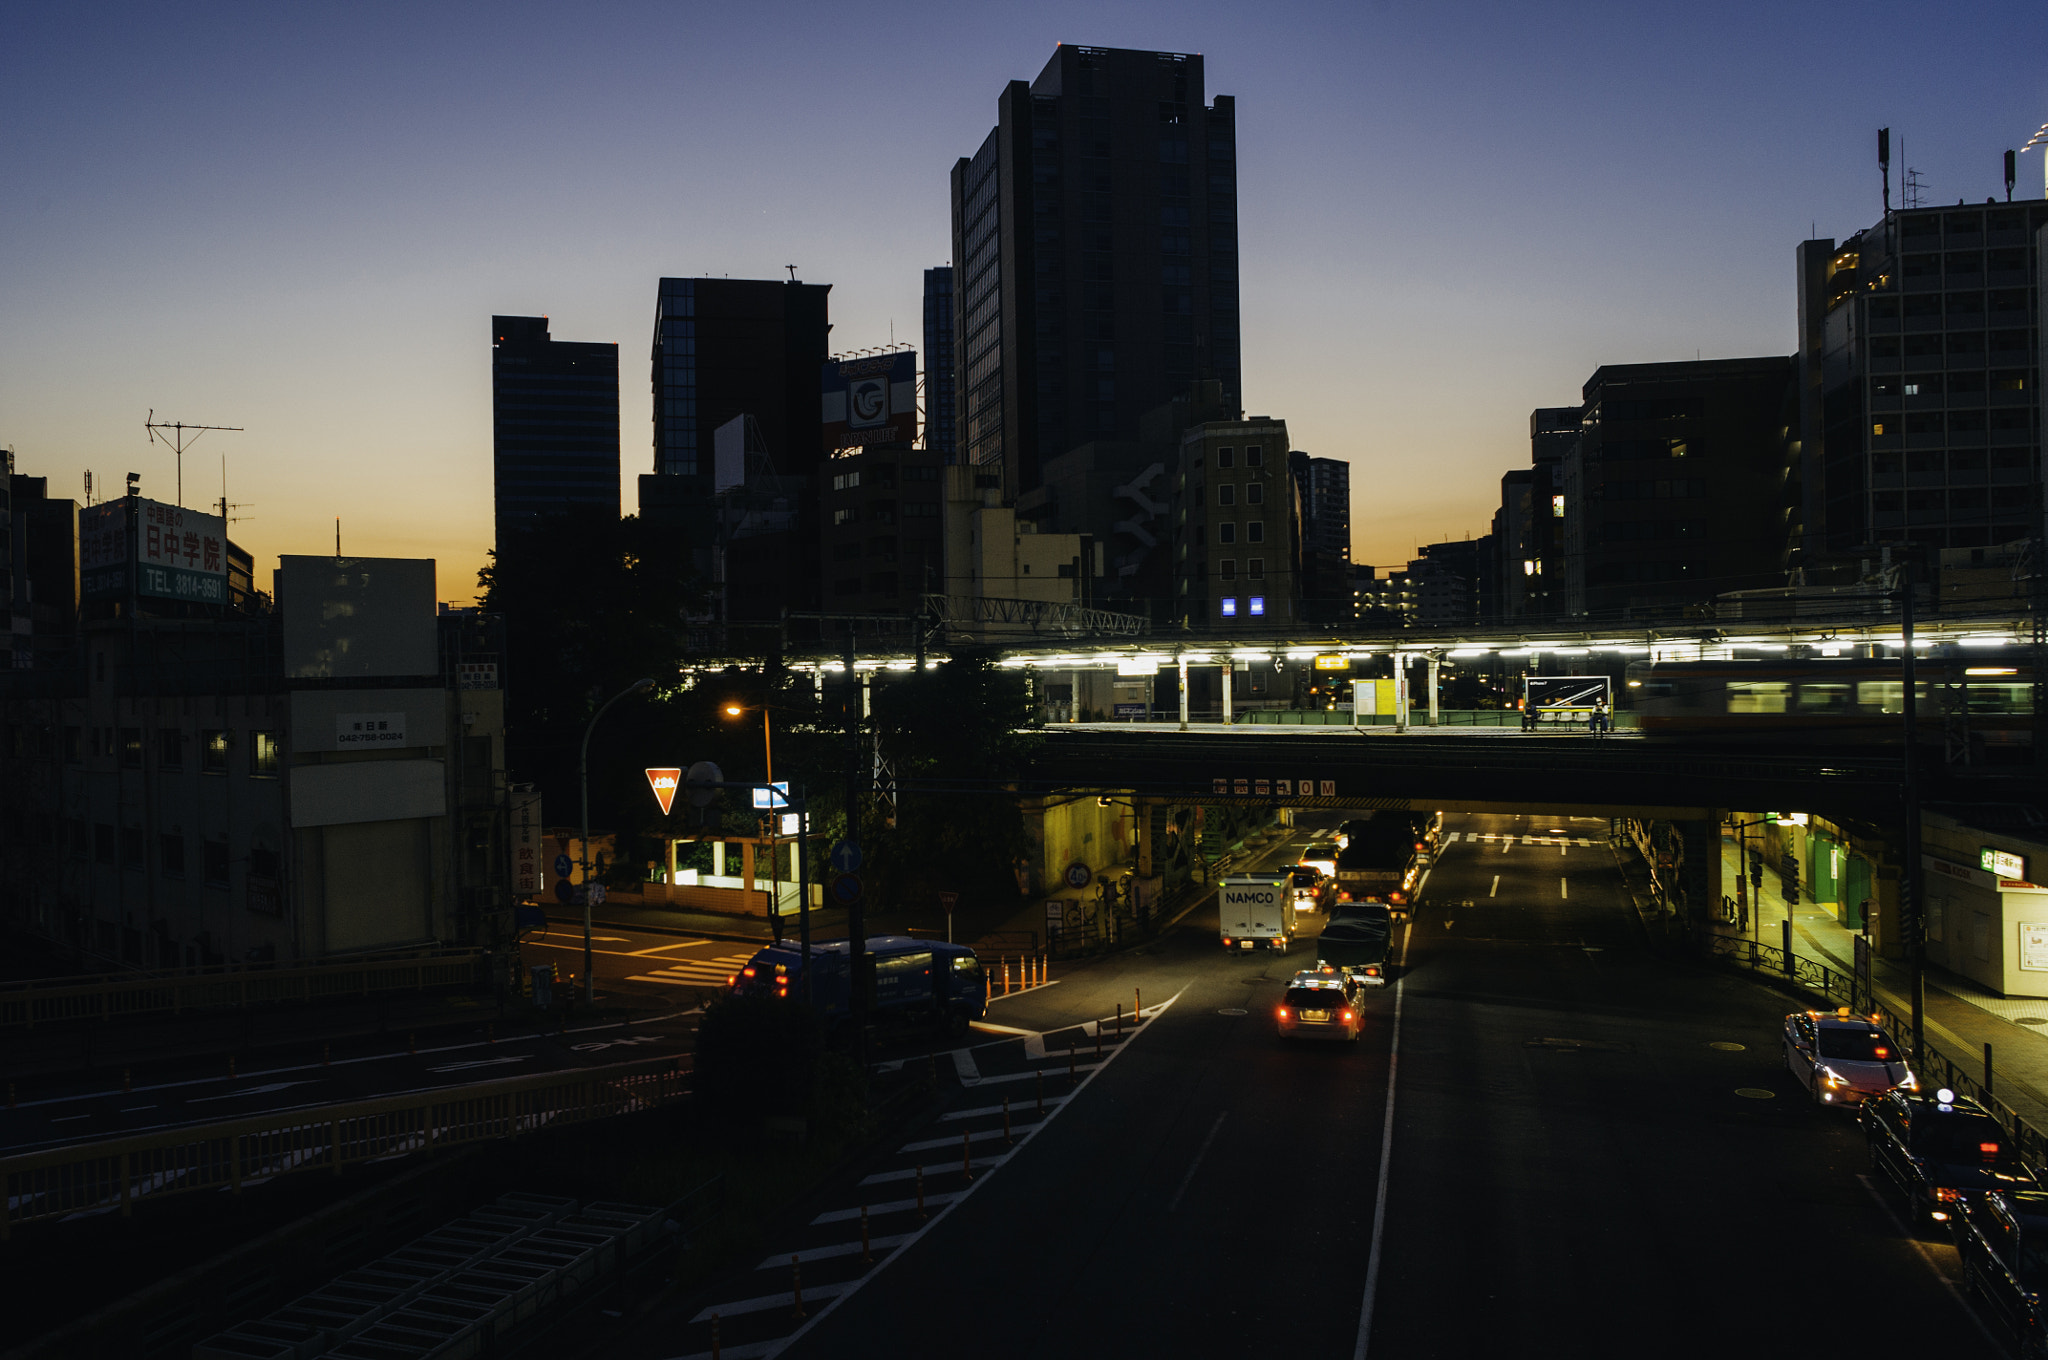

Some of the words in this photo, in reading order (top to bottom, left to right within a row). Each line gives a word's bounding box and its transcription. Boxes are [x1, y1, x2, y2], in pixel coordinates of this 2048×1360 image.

[841, 431, 873, 447] JAPAN
[873, 426, 898, 441] LIFE
[147, 505, 183, 528] 中国語の
[147, 525, 220, 572] 日中学院
[147, 568, 171, 593] TEL
[176, 573, 222, 599] 3814-3591
[518, 847, 534, 890] 飲食街
[1226, 892, 1274, 904] NAMCO
